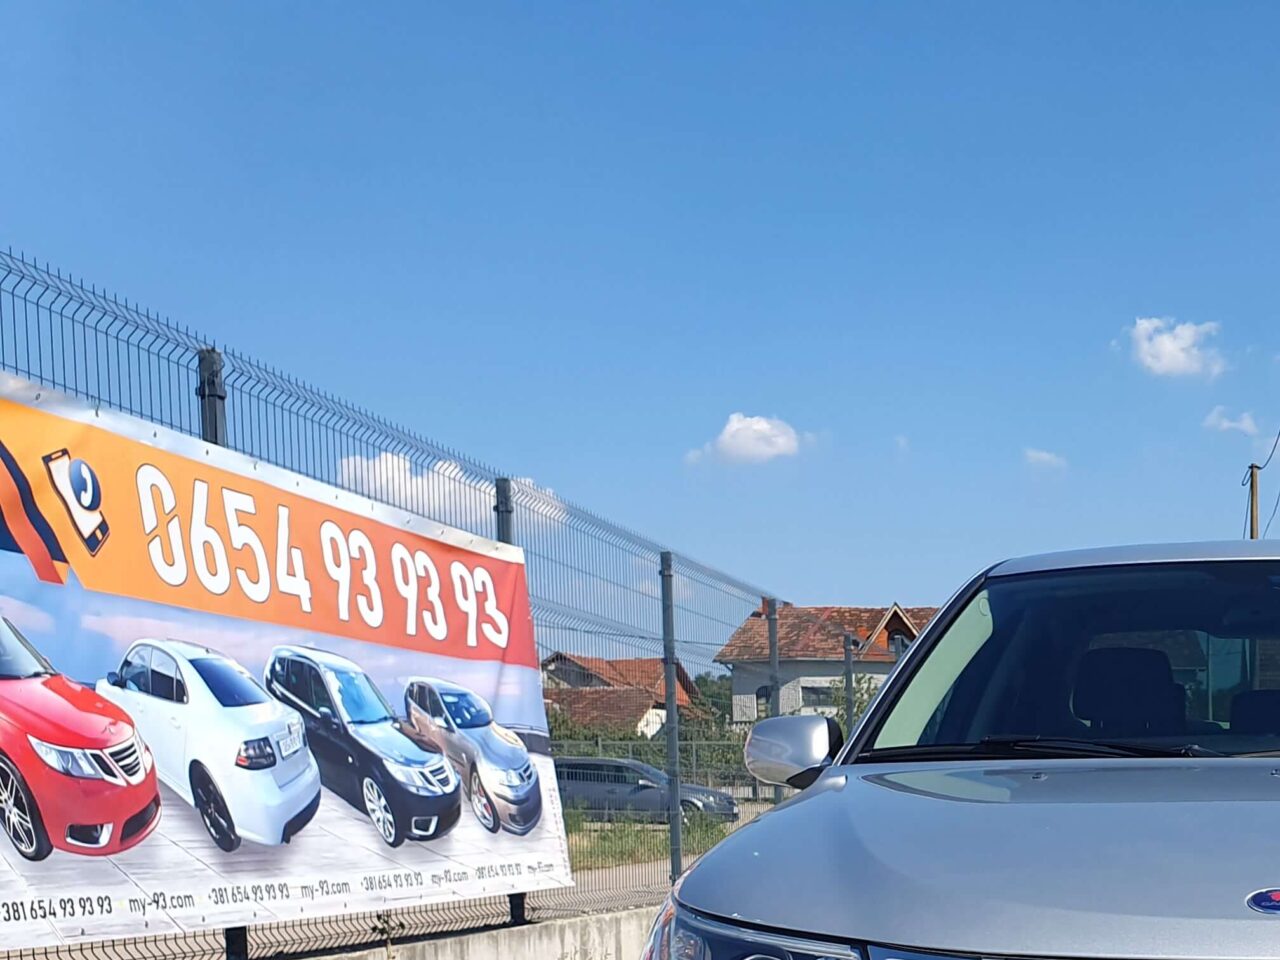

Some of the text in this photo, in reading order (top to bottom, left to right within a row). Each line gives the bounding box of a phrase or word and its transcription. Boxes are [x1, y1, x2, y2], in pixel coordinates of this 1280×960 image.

[136, 463, 509, 648] 0654 93 93 93
[30, 898, 57, 920] 654
[59, 897, 75, 918] 93
[79, 896, 94, 917] 93
[97, 895, 113, 915] 93
[128, 891, 195, 916] my-93.com
[207, 887, 230, 905] +381
[231, 885, 250, 903] 654
[251, 884, 264, 902] 93
[265, 883, 277, 901] 93
[278, 882, 290, 900] 93
[300, 879, 351, 900] my-93.com
[393, 873, 403, 889] 93
[404, 872, 413, 887] 93
[414, 871, 423, 886] 93
